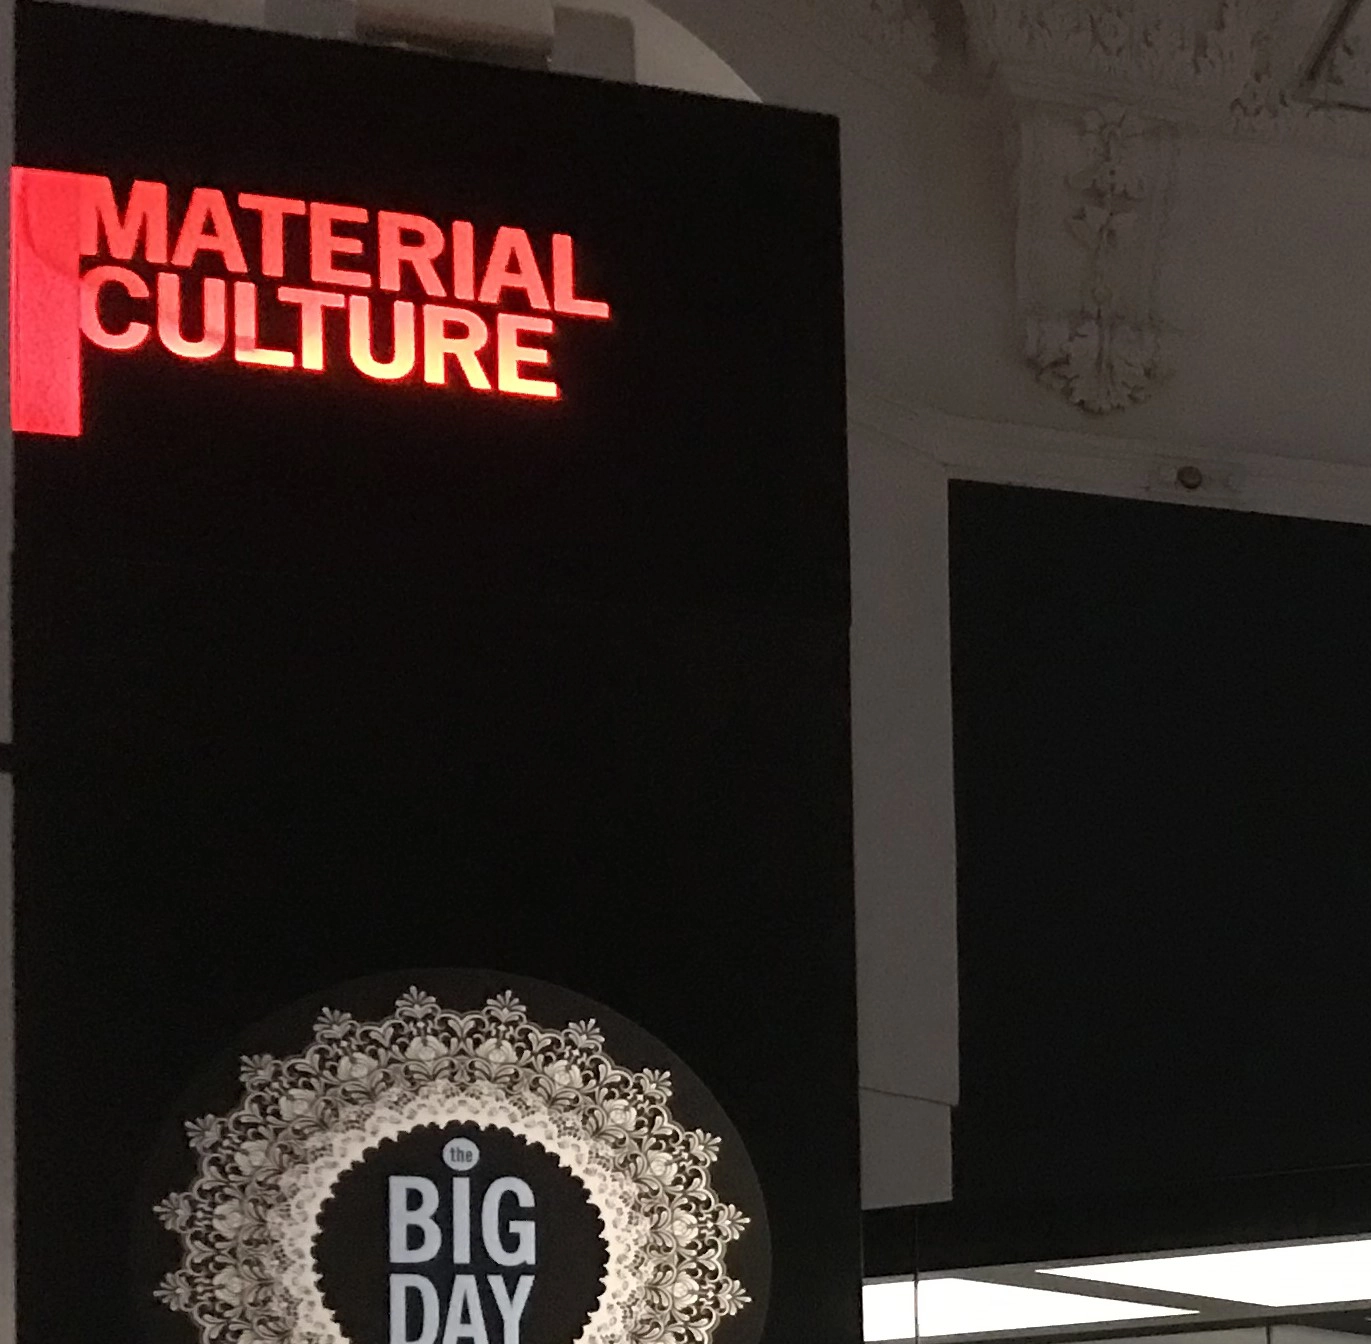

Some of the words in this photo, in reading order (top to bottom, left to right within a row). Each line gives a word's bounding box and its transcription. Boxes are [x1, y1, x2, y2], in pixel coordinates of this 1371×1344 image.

[80, 174, 610, 319] MATERIAL
[79, 265, 559, 398] CULTURE
[450, 1146, 473, 1163] the
[388, 1175, 536, 1267] BIG
